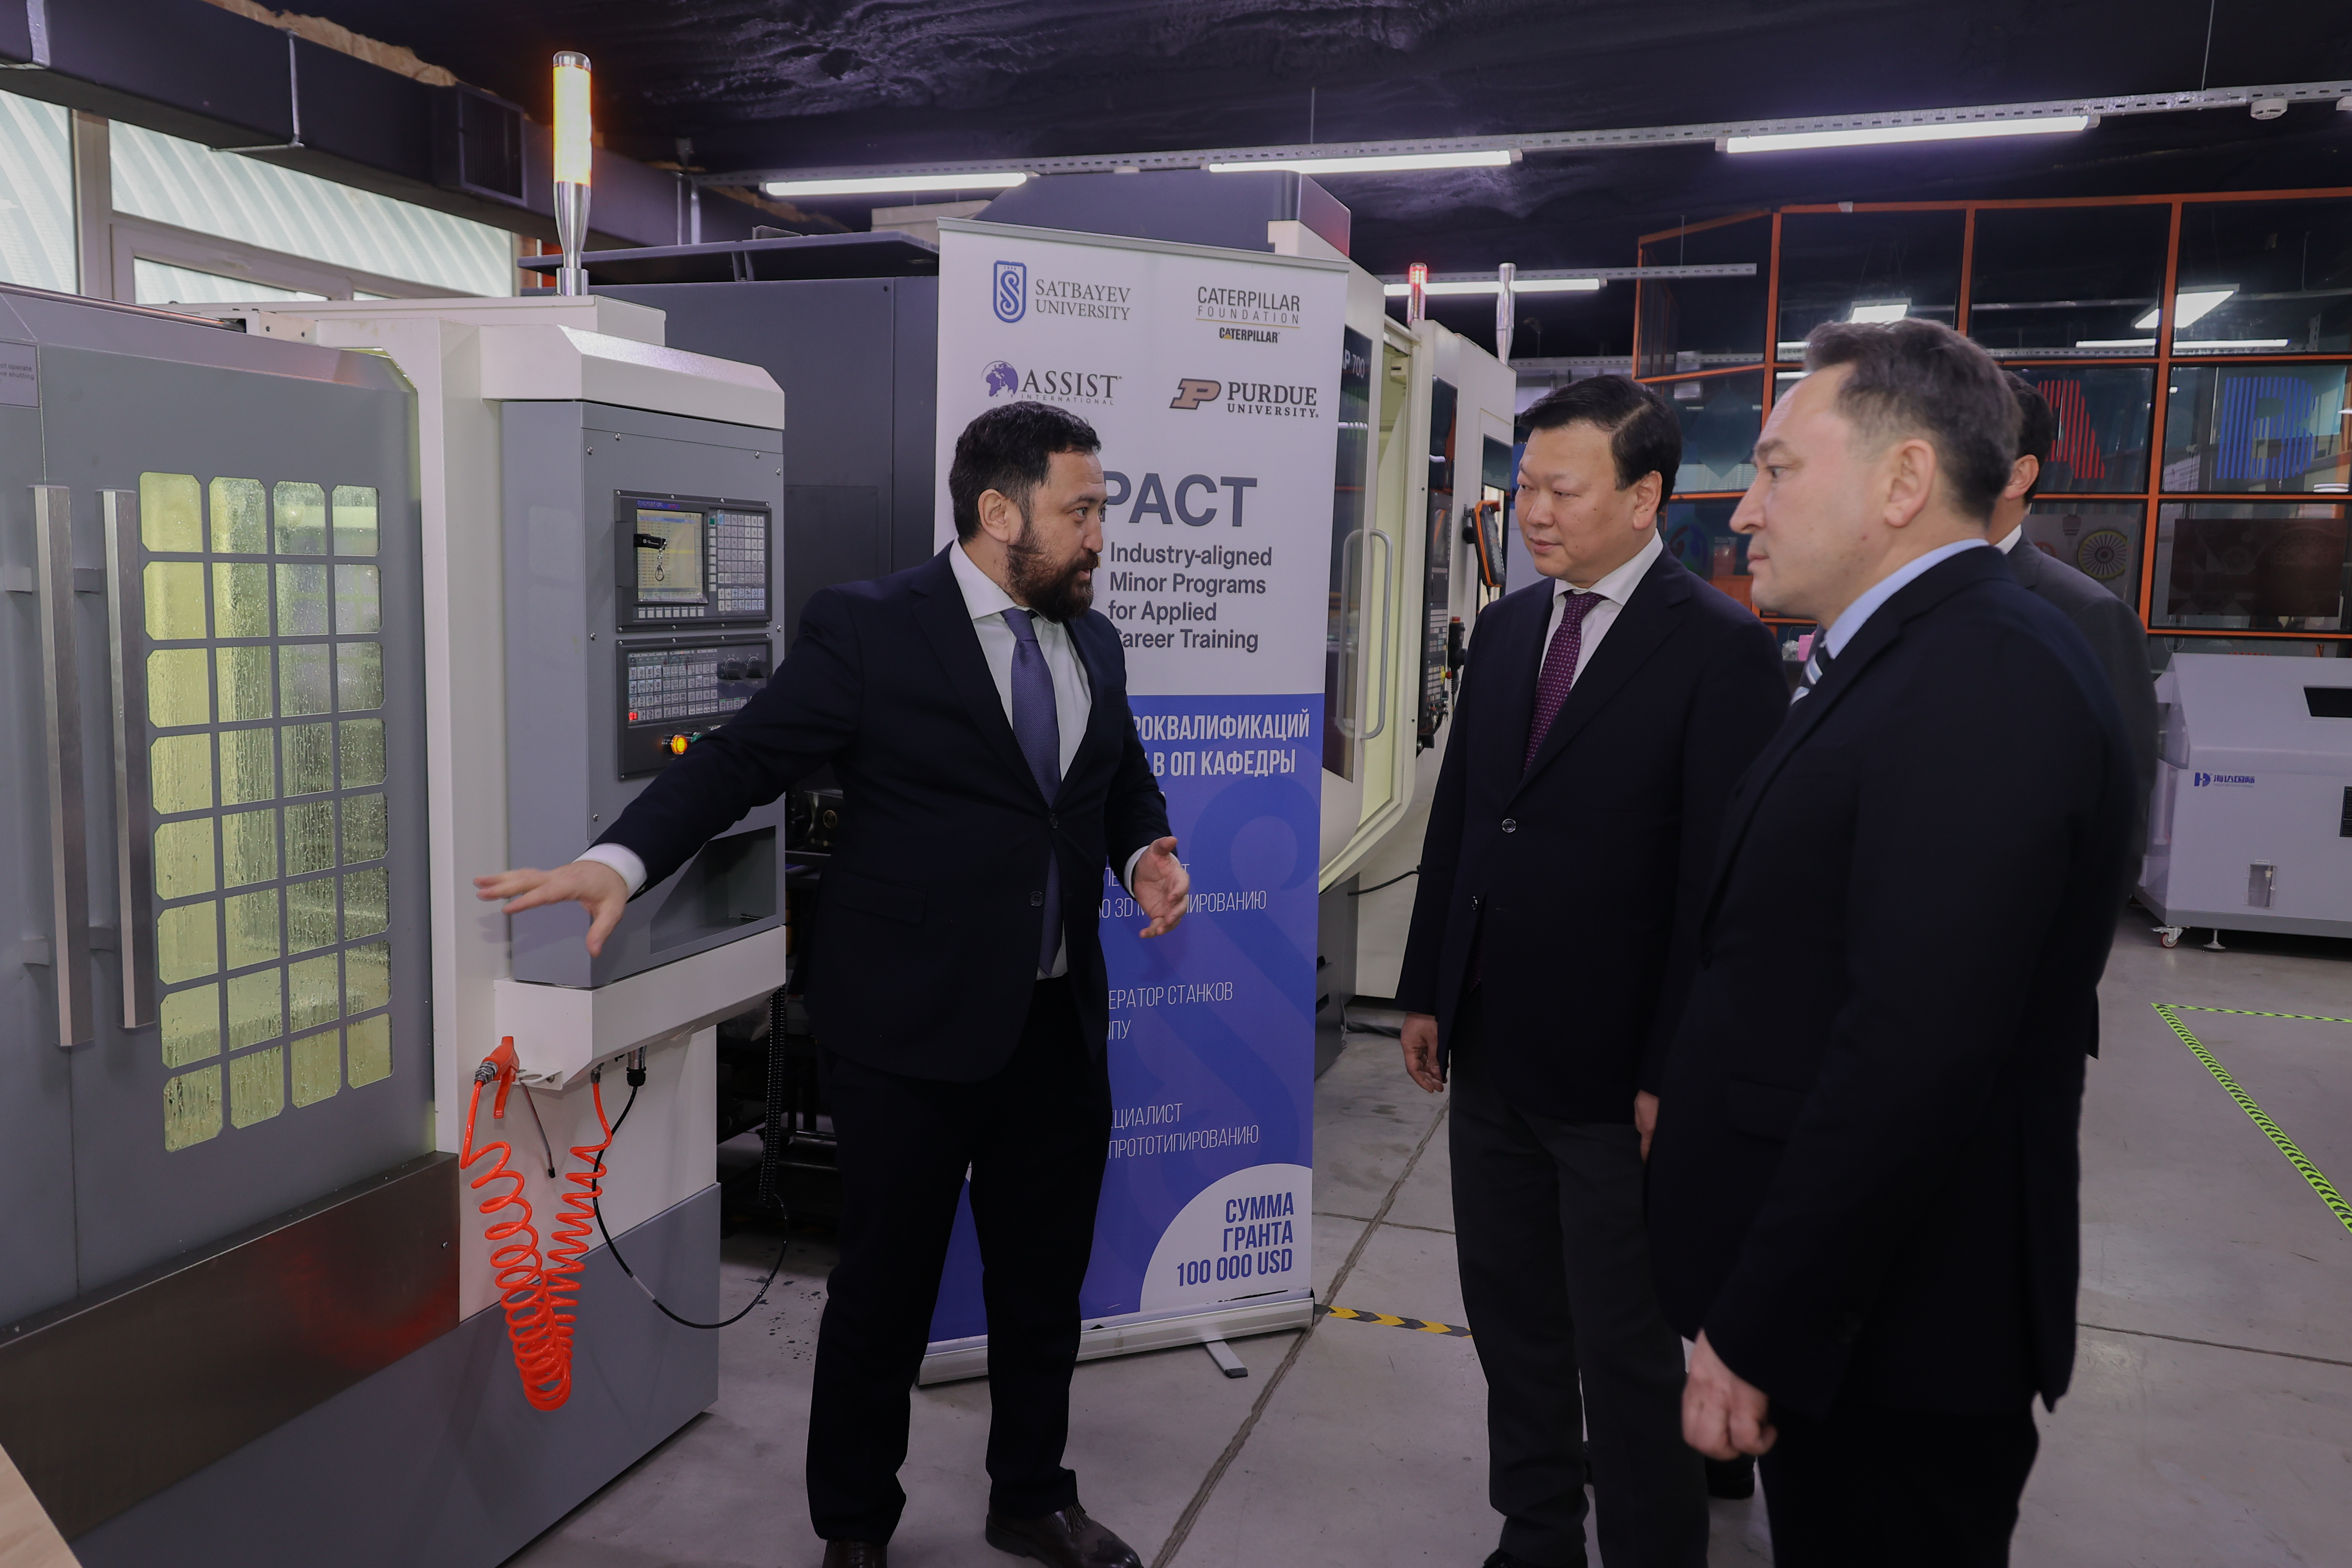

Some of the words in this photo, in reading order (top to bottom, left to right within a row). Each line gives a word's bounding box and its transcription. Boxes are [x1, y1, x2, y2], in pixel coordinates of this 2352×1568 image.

[1035, 279, 1131, 303] SATBAYEV
[1197, 286, 1300, 312] CATERPILLAR
[1035, 299, 1130, 320] UNIVERSITY
[1198, 305, 1298, 324] FOUNDATION
[1352, 353, 1365, 378] 700
[1021, 394, 1114, 405] INTERNATIONAL
[1227, 381, 1317, 406] PURDUE
[1102, 470, 1258, 527] PACT
[1110, 542, 1272, 569] Industry-aligned
[1110, 571, 1167, 592] Minor
[1173, 573, 1266, 597] Programs
[1108, 600, 1136, 619] for
[1140, 600, 1217, 625] Applied
[1180, 628, 1259, 653] Training
[1153, 752, 1165, 776] В
[1170, 751, 1196, 776] ОП
[1201, 749, 1296, 778] КАФЕДРЫ
[1115, 897, 1133, 917] 3D
[1109, 987, 1164, 1010] ЕРАТОР
[1168, 982, 1234, 1005] СТАНКОВ
[1111, 1103, 1183, 1130] ЦИАЛИСТ
[1109, 1124, 1259, 1160] ПРОТОТИПИРОВАНИЮ
[1225, 1191, 1294, 1223] СУММА
[1223, 1220, 1293, 1252] ГРАНТА
[1176, 1259, 1211, 1286] 100
[1216, 1253, 1252, 1281] 000
[1257, 1248, 1293, 1275] USD
